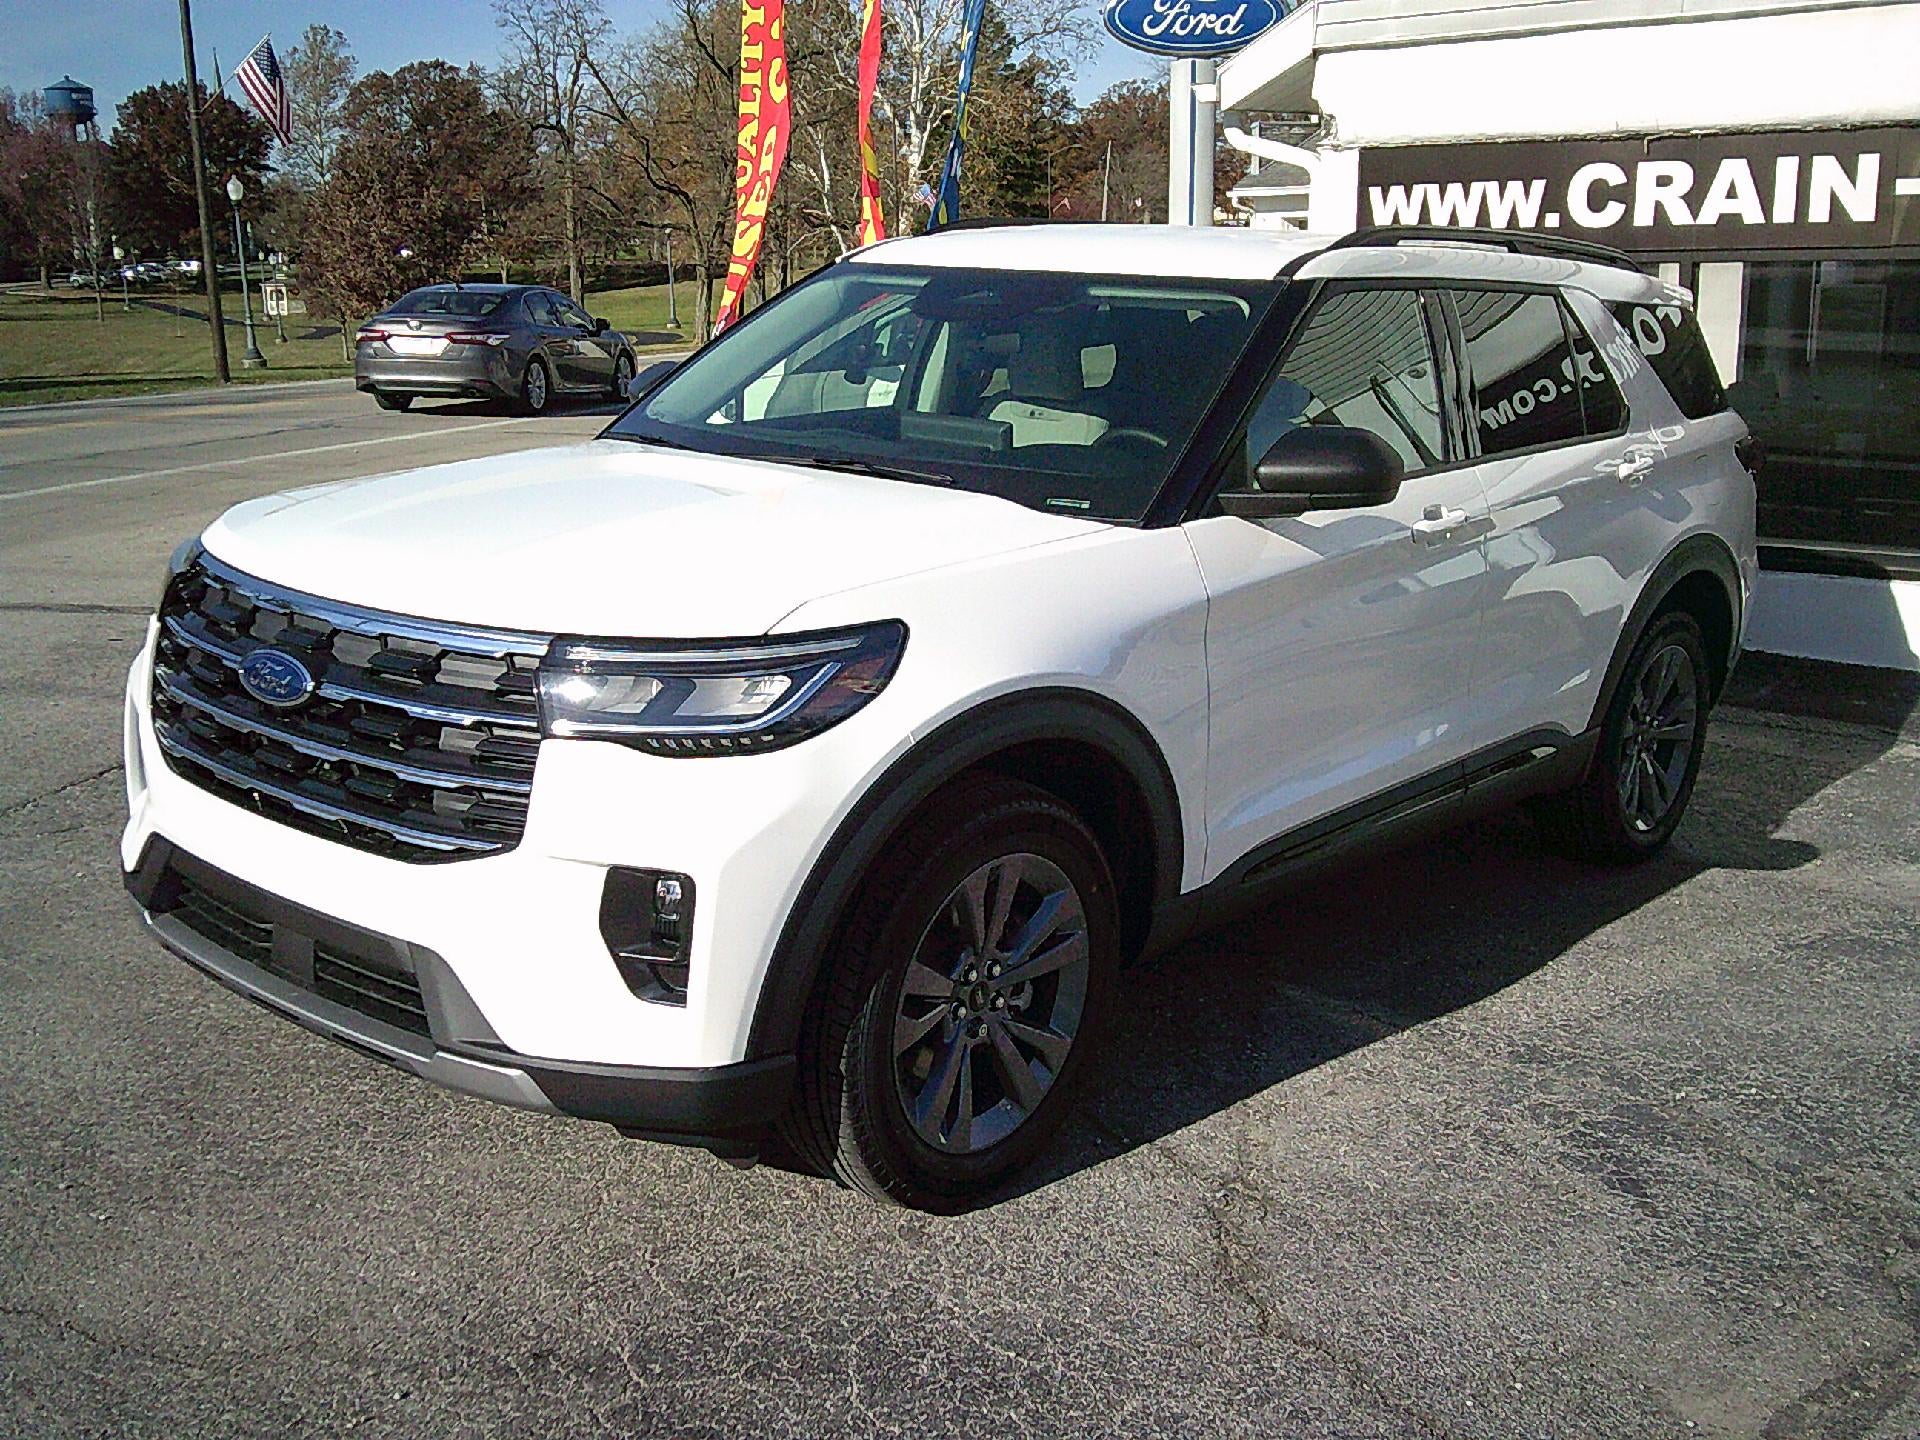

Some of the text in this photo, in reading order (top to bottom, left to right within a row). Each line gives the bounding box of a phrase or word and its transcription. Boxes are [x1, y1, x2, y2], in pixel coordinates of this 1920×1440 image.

[1142, 0, 1248, 36] Ford
[733, 0, 765, 210] UALITY
[249, 660, 293, 694] Ford
